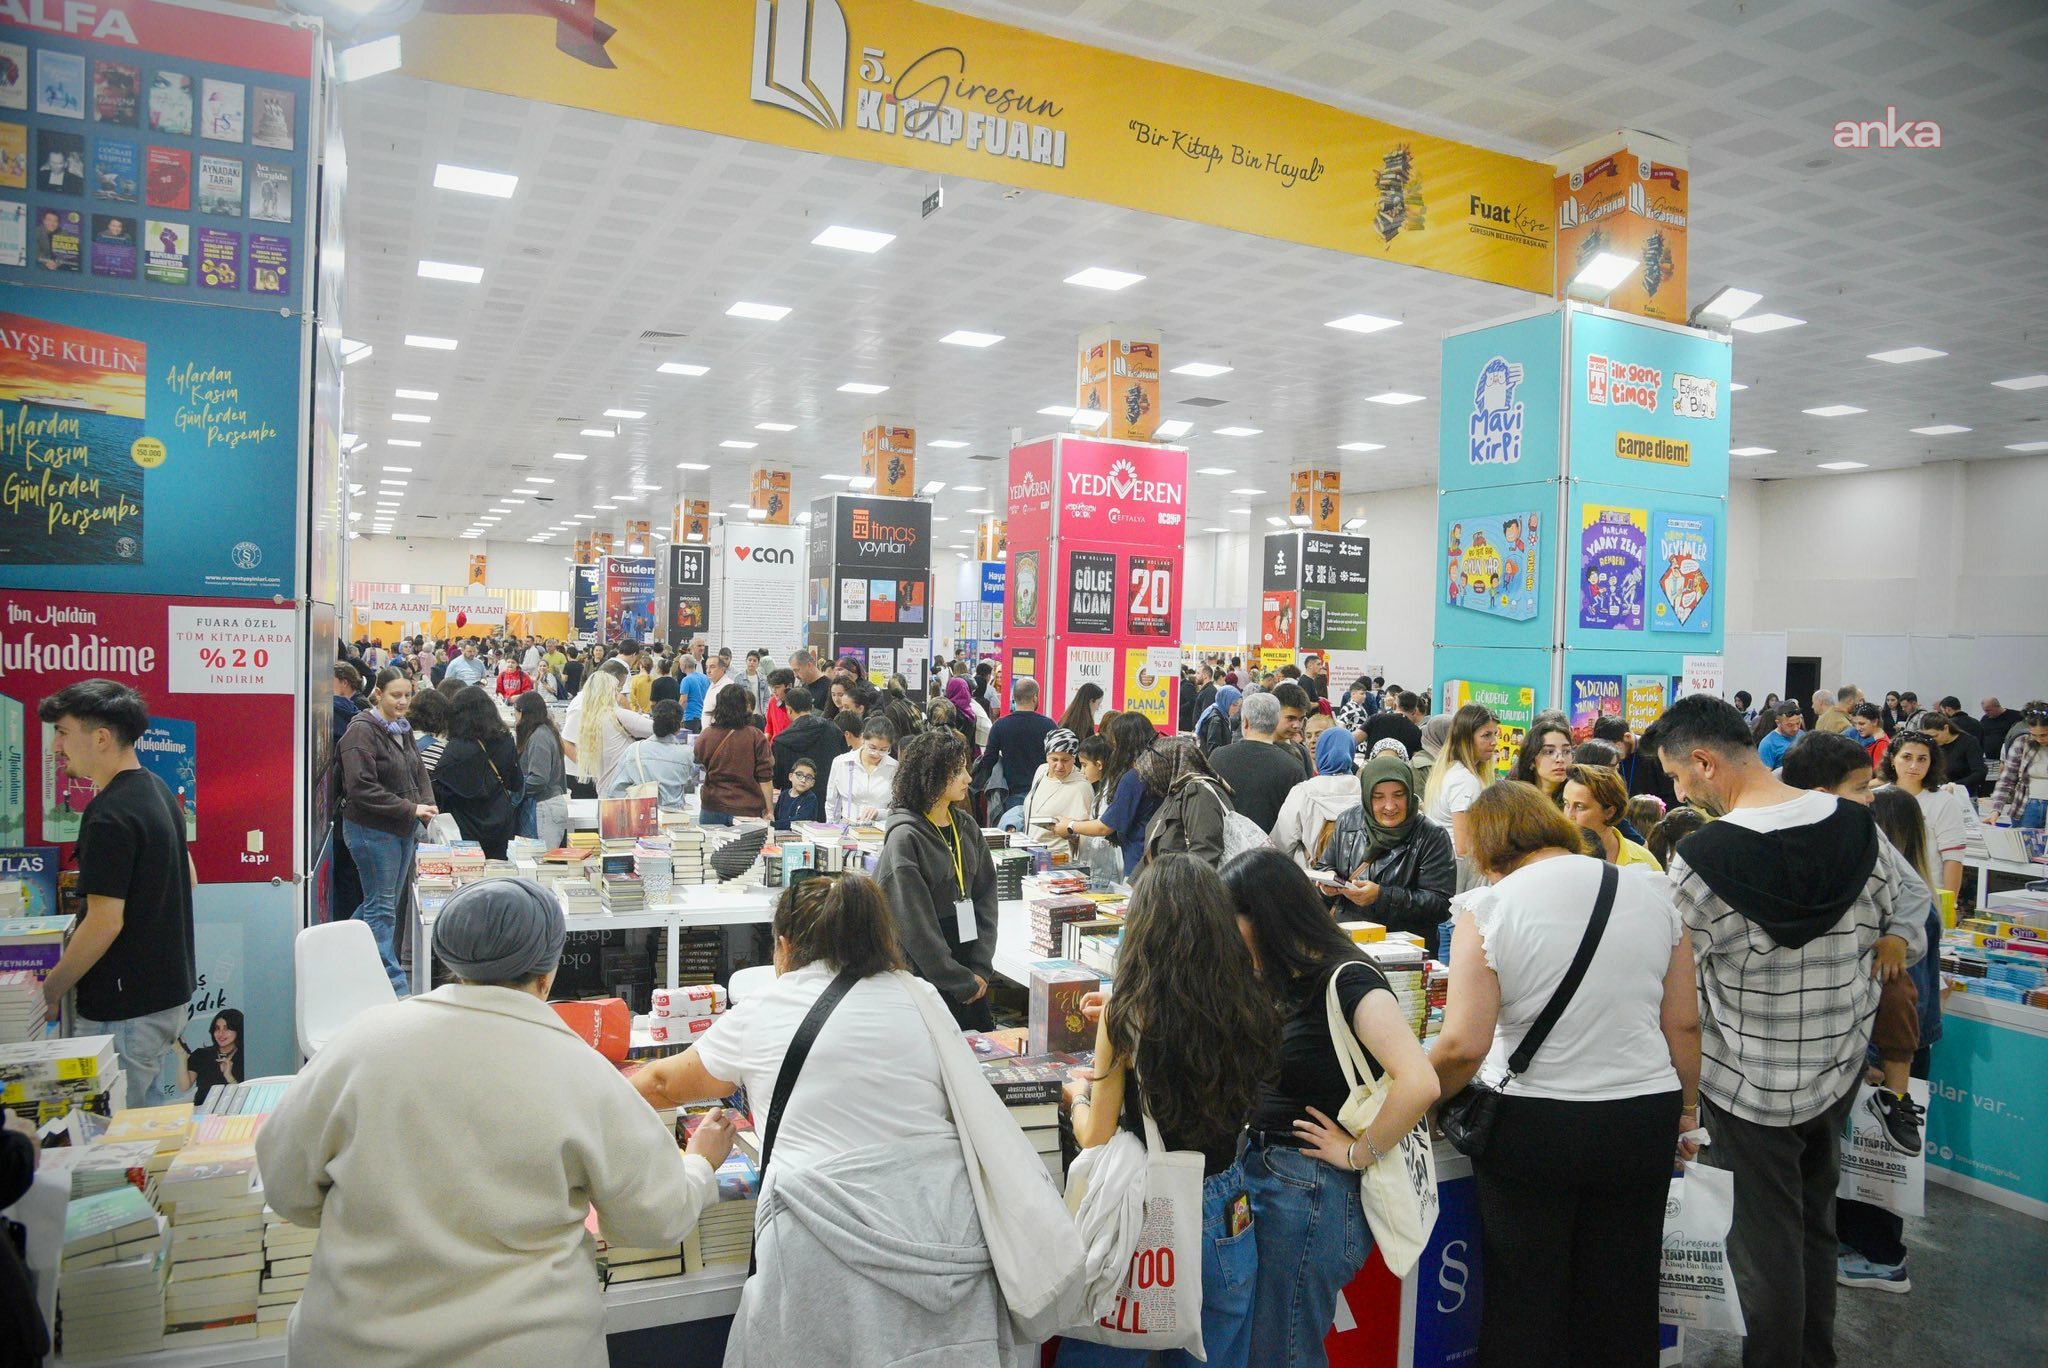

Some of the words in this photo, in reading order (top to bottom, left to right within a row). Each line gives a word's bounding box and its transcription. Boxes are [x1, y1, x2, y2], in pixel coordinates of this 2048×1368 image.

[859, 47, 892, 84] 5.
[893, 47, 1064, 132] Giresun
[966, 111, 1067, 168] FUARI
[1172, 130, 1224, 173] Kitap,
[1232, 144, 1262, 169] Bin
[1470, 194, 1511, 224] Fuat
[62, 341, 139, 373] KULİN
[166, 362, 233, 392] Aylardan
[1611, 362, 1627, 379] ilk
[1628, 365, 1661, 389] genç
[191, 384, 239, 406] Kasım
[0, 405, 80, 451] ylardan
[175, 407, 247, 432] Günlerden
[207, 421, 278, 449] Perşembe
[26, 440, 89, 472] Kasım
[1618, 437, 1653, 459] carpe
[1654, 440, 1689, 462] diem!
[3, 469, 100, 514] Günlerden
[49, 494, 140, 535] Perşembe
[871, 520, 917, 547] timaş
[752, 547, 795, 565] can
[1074, 565, 1114, 593] GÖLGE
[1072, 592, 1112, 615] ADAM
[1130, 568, 1171, 616] 20
[7, 599, 33, 624] İbn
[35, 605, 98, 627] Haldûn
[400, 603, 429, 612] ALANI
[475, 606, 504, 615] ALANI
[196, 617, 240, 628] FUARA
[244, 617, 278, 628] ÖZEL
[176, 630, 205, 642] TÜM
[210, 632, 293, 643] KİTAPLARDA
[0, 630, 156, 678] ukaddime
[199, 646, 270, 669] %20
[1070, 650, 1112, 664] MUTLULUK
[210, 673, 265, 685] İNDİRİM
[1079, 664, 1101, 677] YOLU
[1691, 678, 1715, 690] %20
[1127, 698, 1166, 710] PLANLA
[240, 852, 270, 866] kapı
[1858, 1156, 1885, 1169] KASIM
[1886, 1162, 1907, 1173] 2025
[1686, 1250, 1724, 1263] FUARI
[1659, 1273, 1695, 1284] KASIM
[1696, 1276, 1725, 1287] 2025
